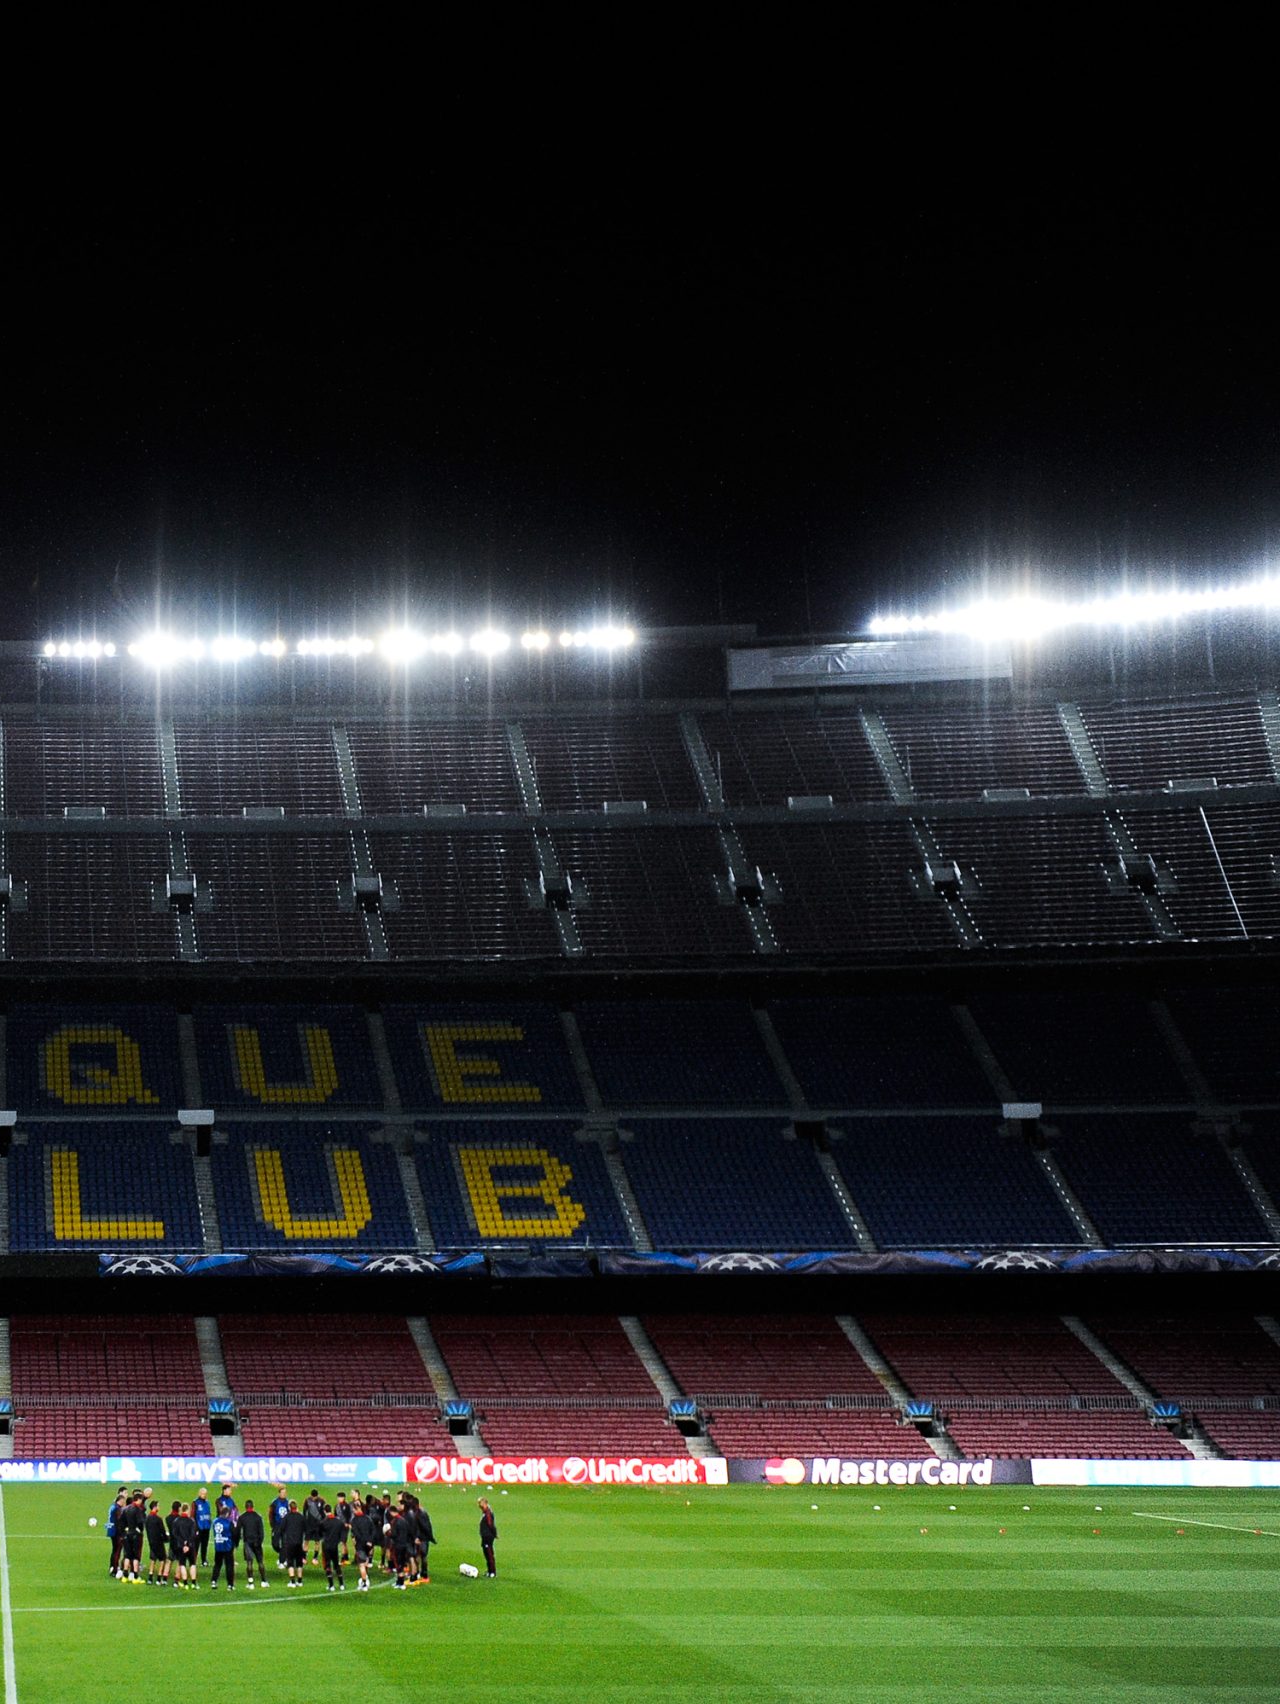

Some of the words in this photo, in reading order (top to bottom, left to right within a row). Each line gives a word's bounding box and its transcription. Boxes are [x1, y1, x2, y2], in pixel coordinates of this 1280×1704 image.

[42, 1025, 541, 1104] QUE
[38, 1461, 101, 1479] LEAGUE
[161, 1458, 310, 1482] PlayStation
[440, 1458, 549, 1482] UniCredit
[588, 1458, 698, 1482] UniCredit
[811, 1458, 993, 1485] MasterCard
